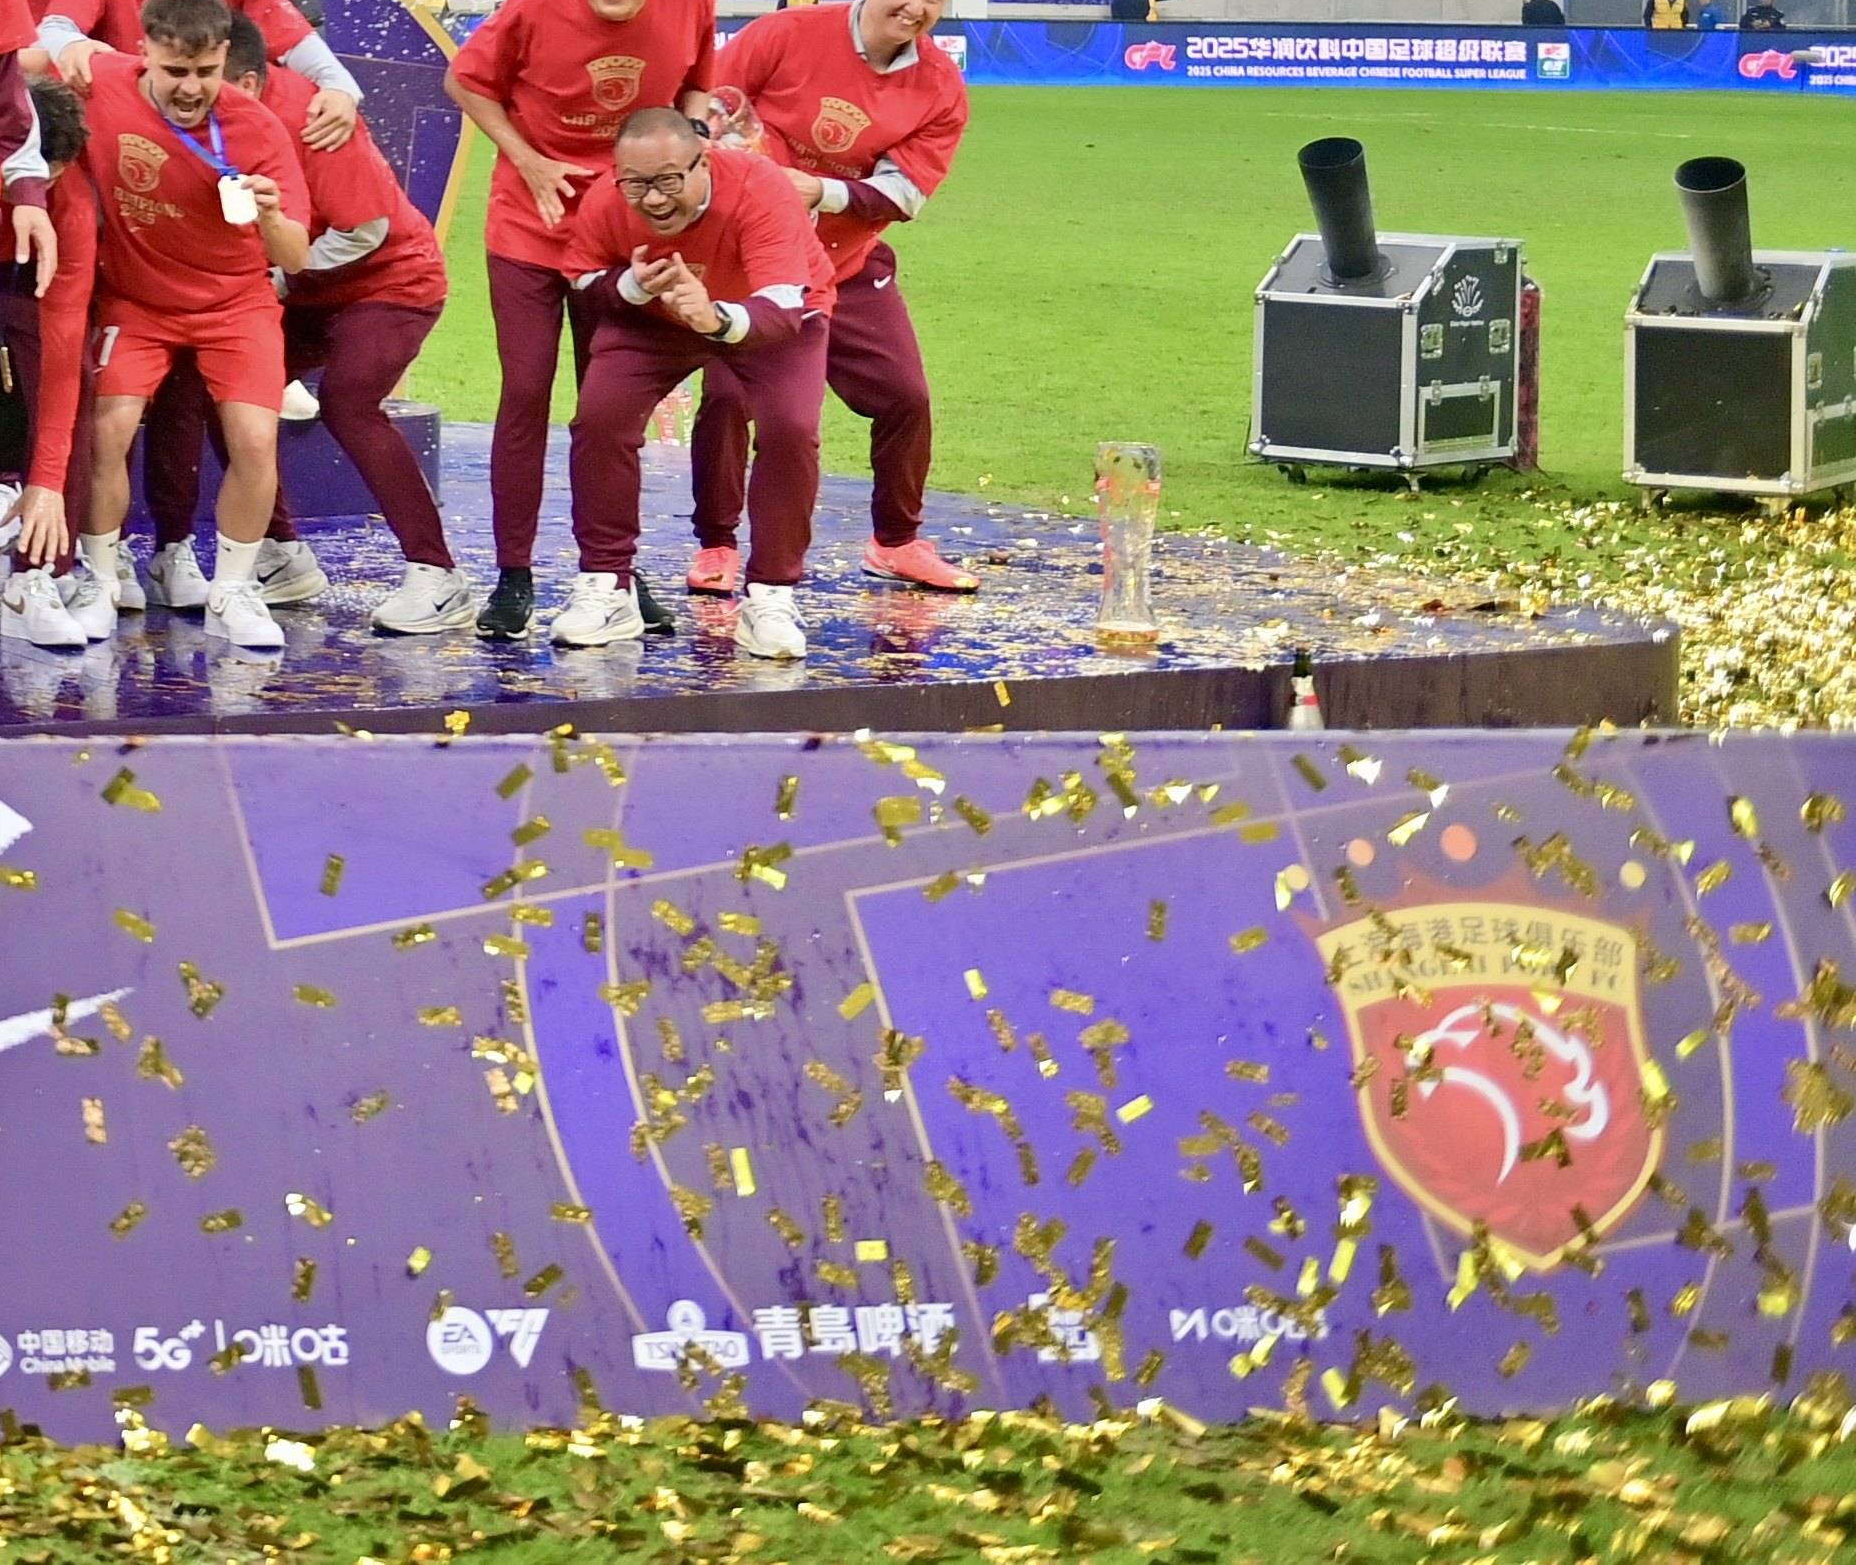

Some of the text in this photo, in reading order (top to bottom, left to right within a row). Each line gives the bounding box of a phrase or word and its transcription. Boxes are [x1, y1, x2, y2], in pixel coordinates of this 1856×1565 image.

[1213, 65, 1245, 77] CHINA
[1247, 66, 1304, 77] RESOURCES
[1306, 66, 1357, 78] BEVERAGE
[1359, 67, 1401, 78] CHINESE
[1402, 67, 1453, 79] FOOTBALL
[1454, 68, 1487, 80] SUPER
[1488, 68, 1527, 80] LEAGUE
[16, 1328, 115, 1355] 中国移动
[441, 1323, 480, 1343] EA
[645, 1338, 741, 1362] TSITAO
